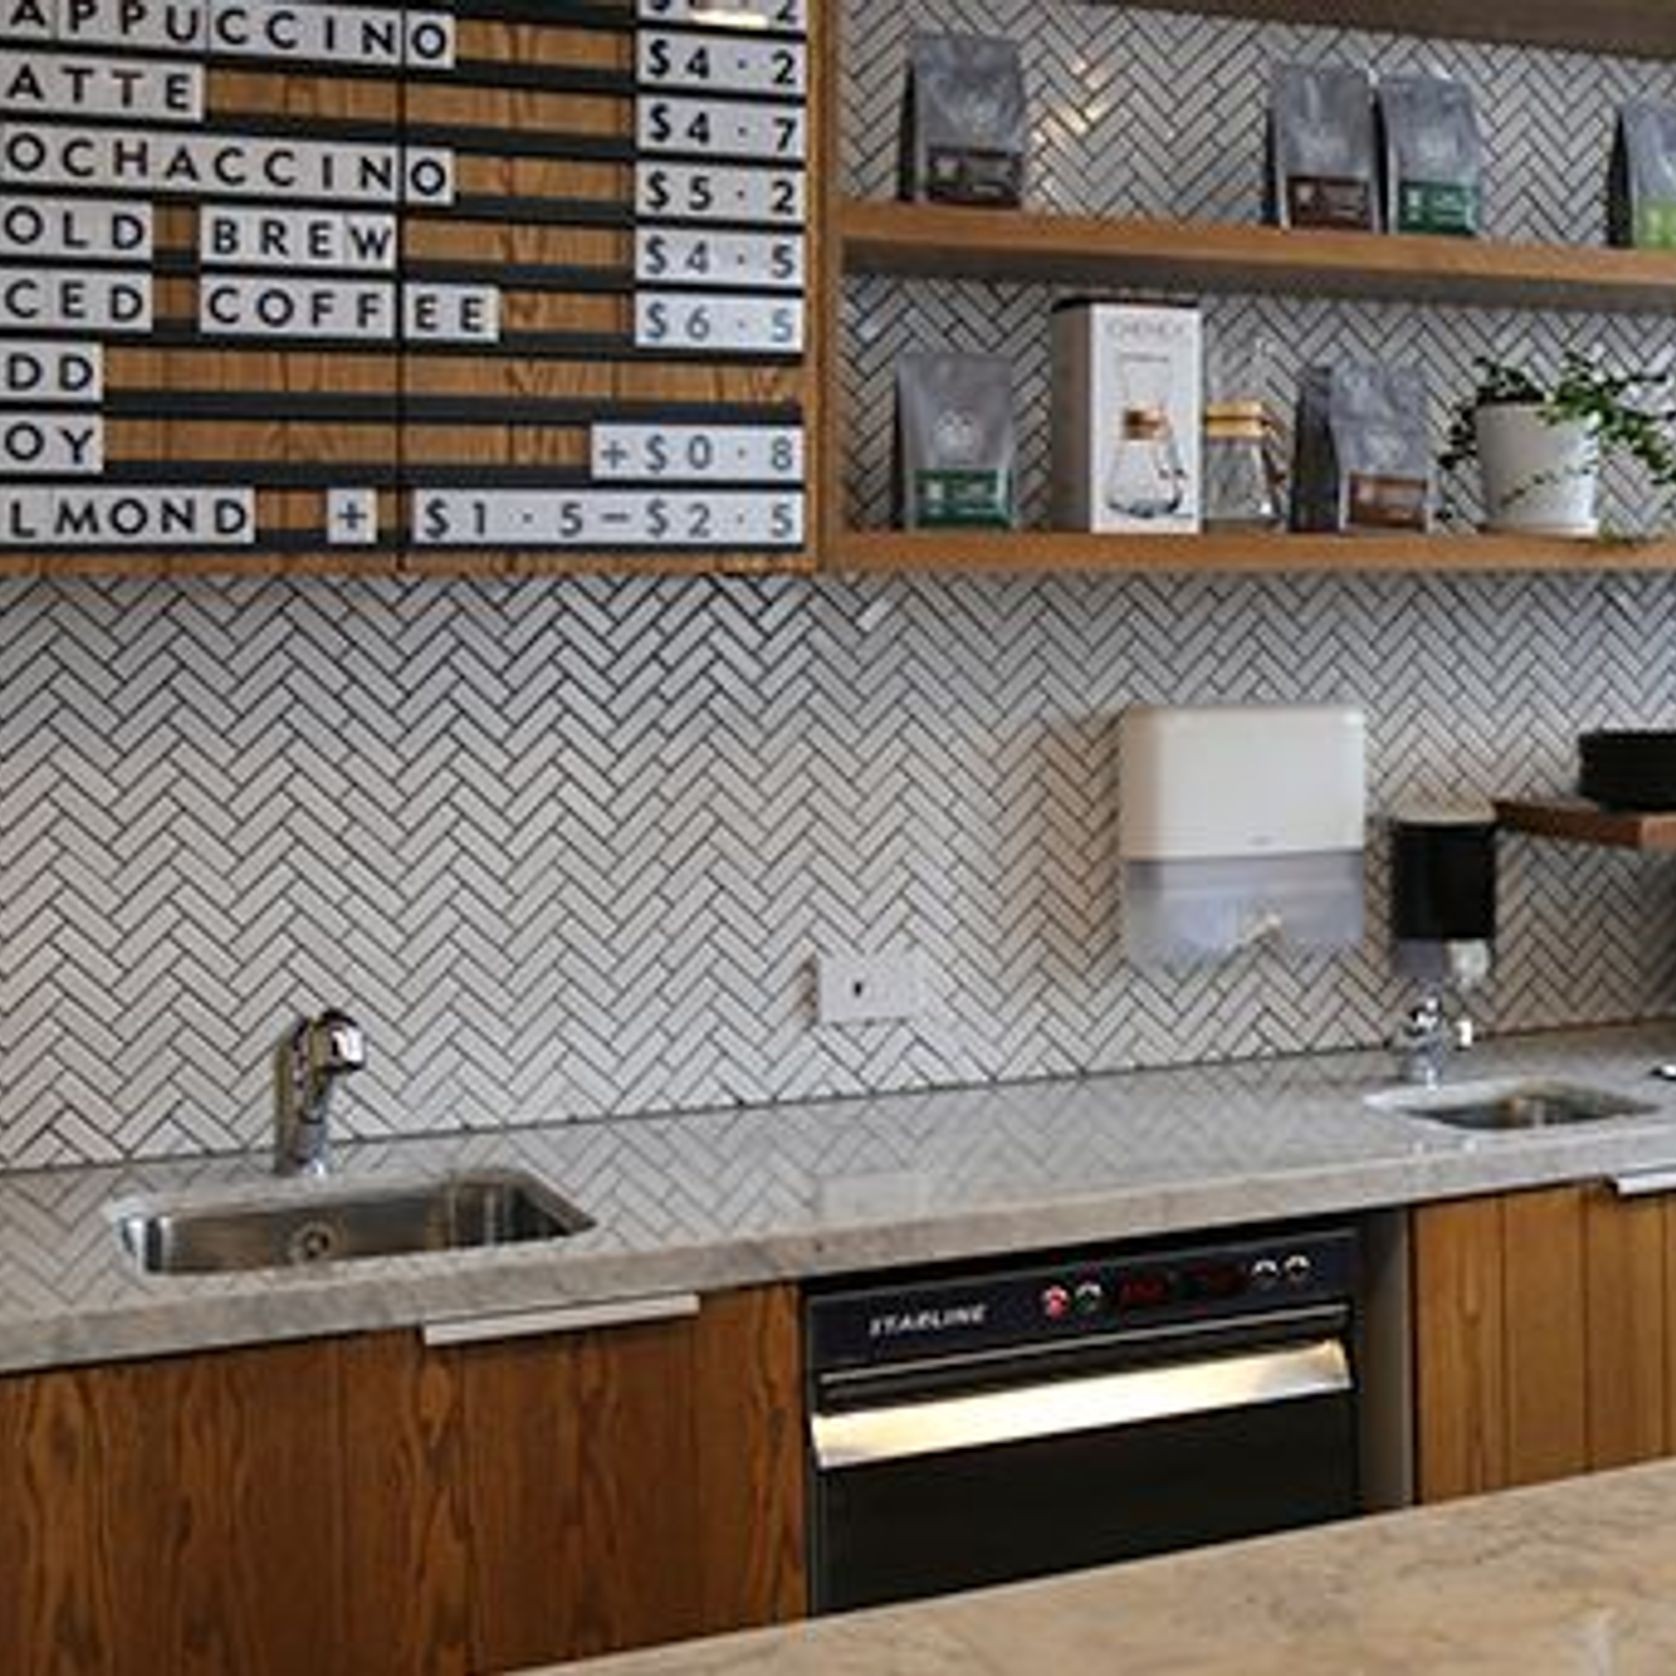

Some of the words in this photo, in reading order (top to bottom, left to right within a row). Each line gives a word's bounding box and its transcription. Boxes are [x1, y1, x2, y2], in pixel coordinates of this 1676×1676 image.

[10, 0, 447, 59] APPUCCINO
[8, 65, 191, 111] ATTE
[6, 132, 446, 196] OCHACCINO
[4, 205, 145, 249] OLD
[213, 218, 392, 260] BREW
[5, 279, 144, 323] CED
[208, 286, 484, 332] COFFEE
[7, 352, 94, 390] DD
[4, 421, 94, 463] OY
[10, 498, 248, 537] LMOND
